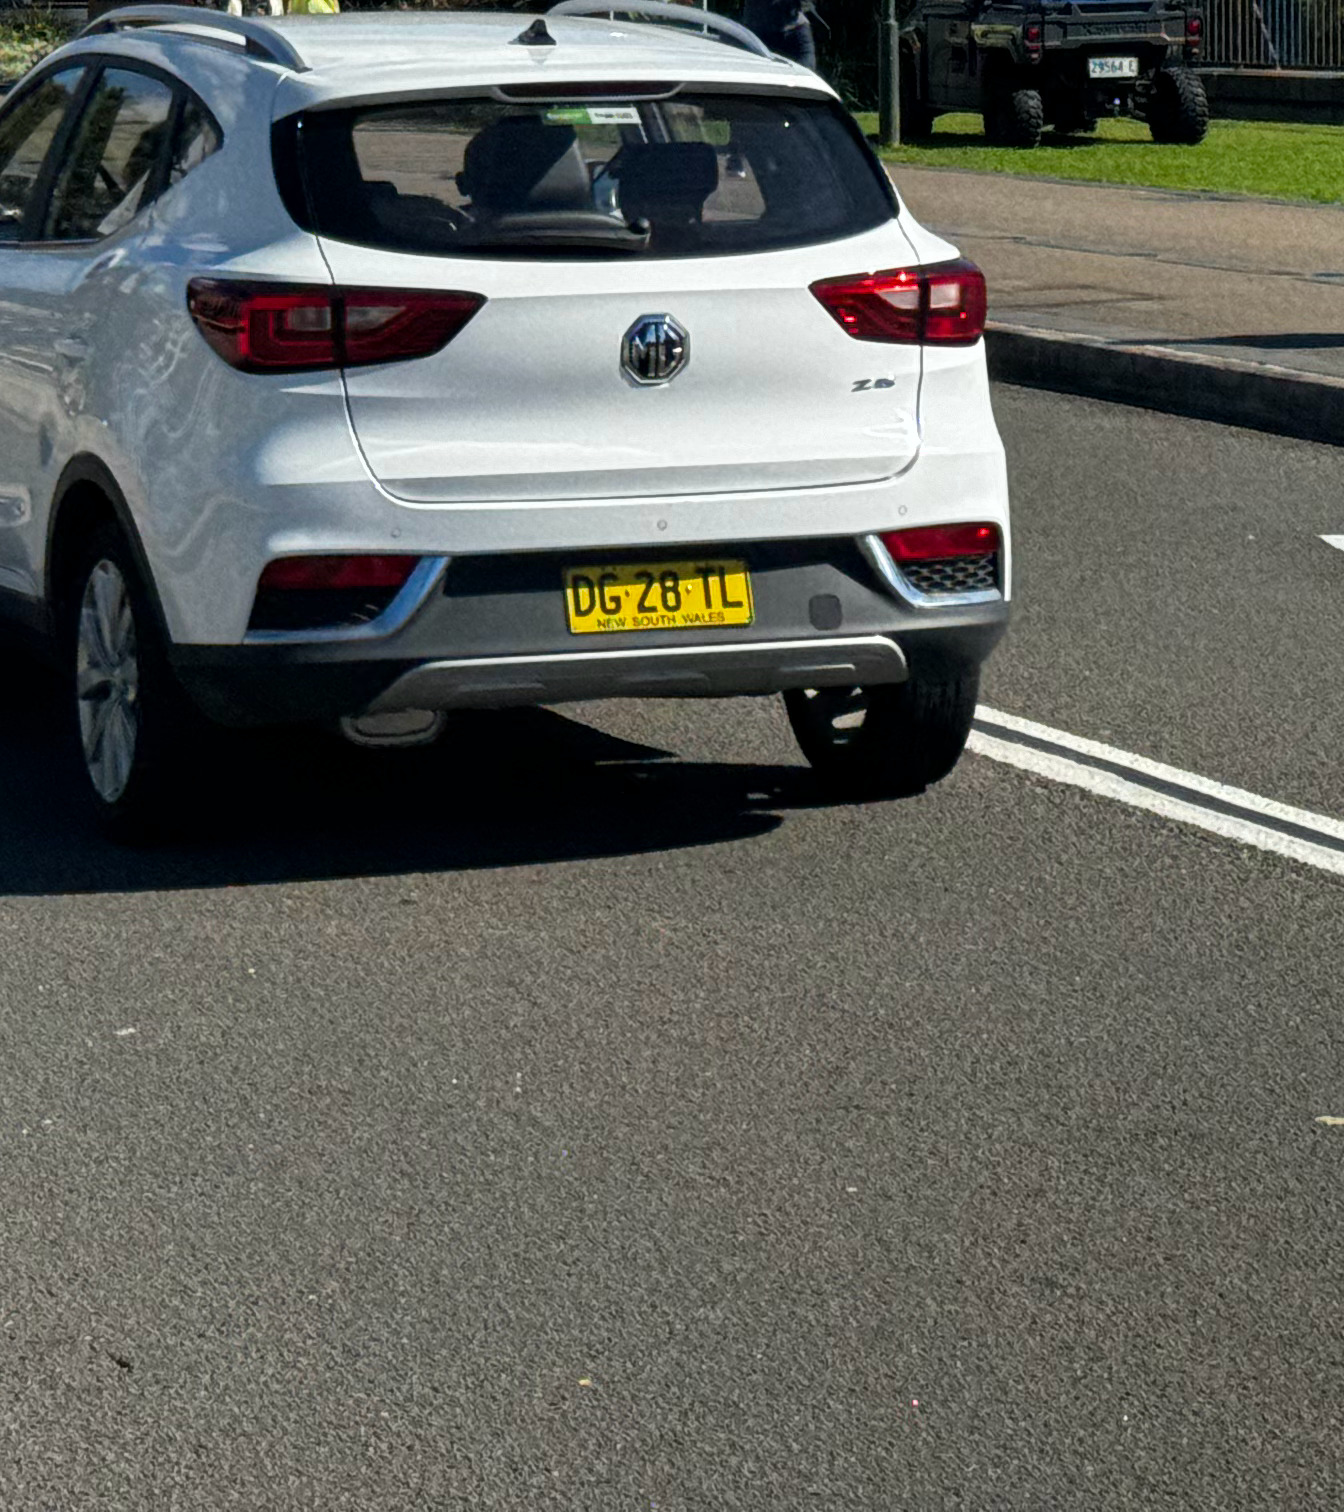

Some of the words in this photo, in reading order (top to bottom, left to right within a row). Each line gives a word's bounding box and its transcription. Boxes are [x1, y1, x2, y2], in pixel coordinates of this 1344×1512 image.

[597, 617, 626, 629] NEW
[632, 614, 677, 627] SOUTH
[682, 611, 726, 624] WALES
